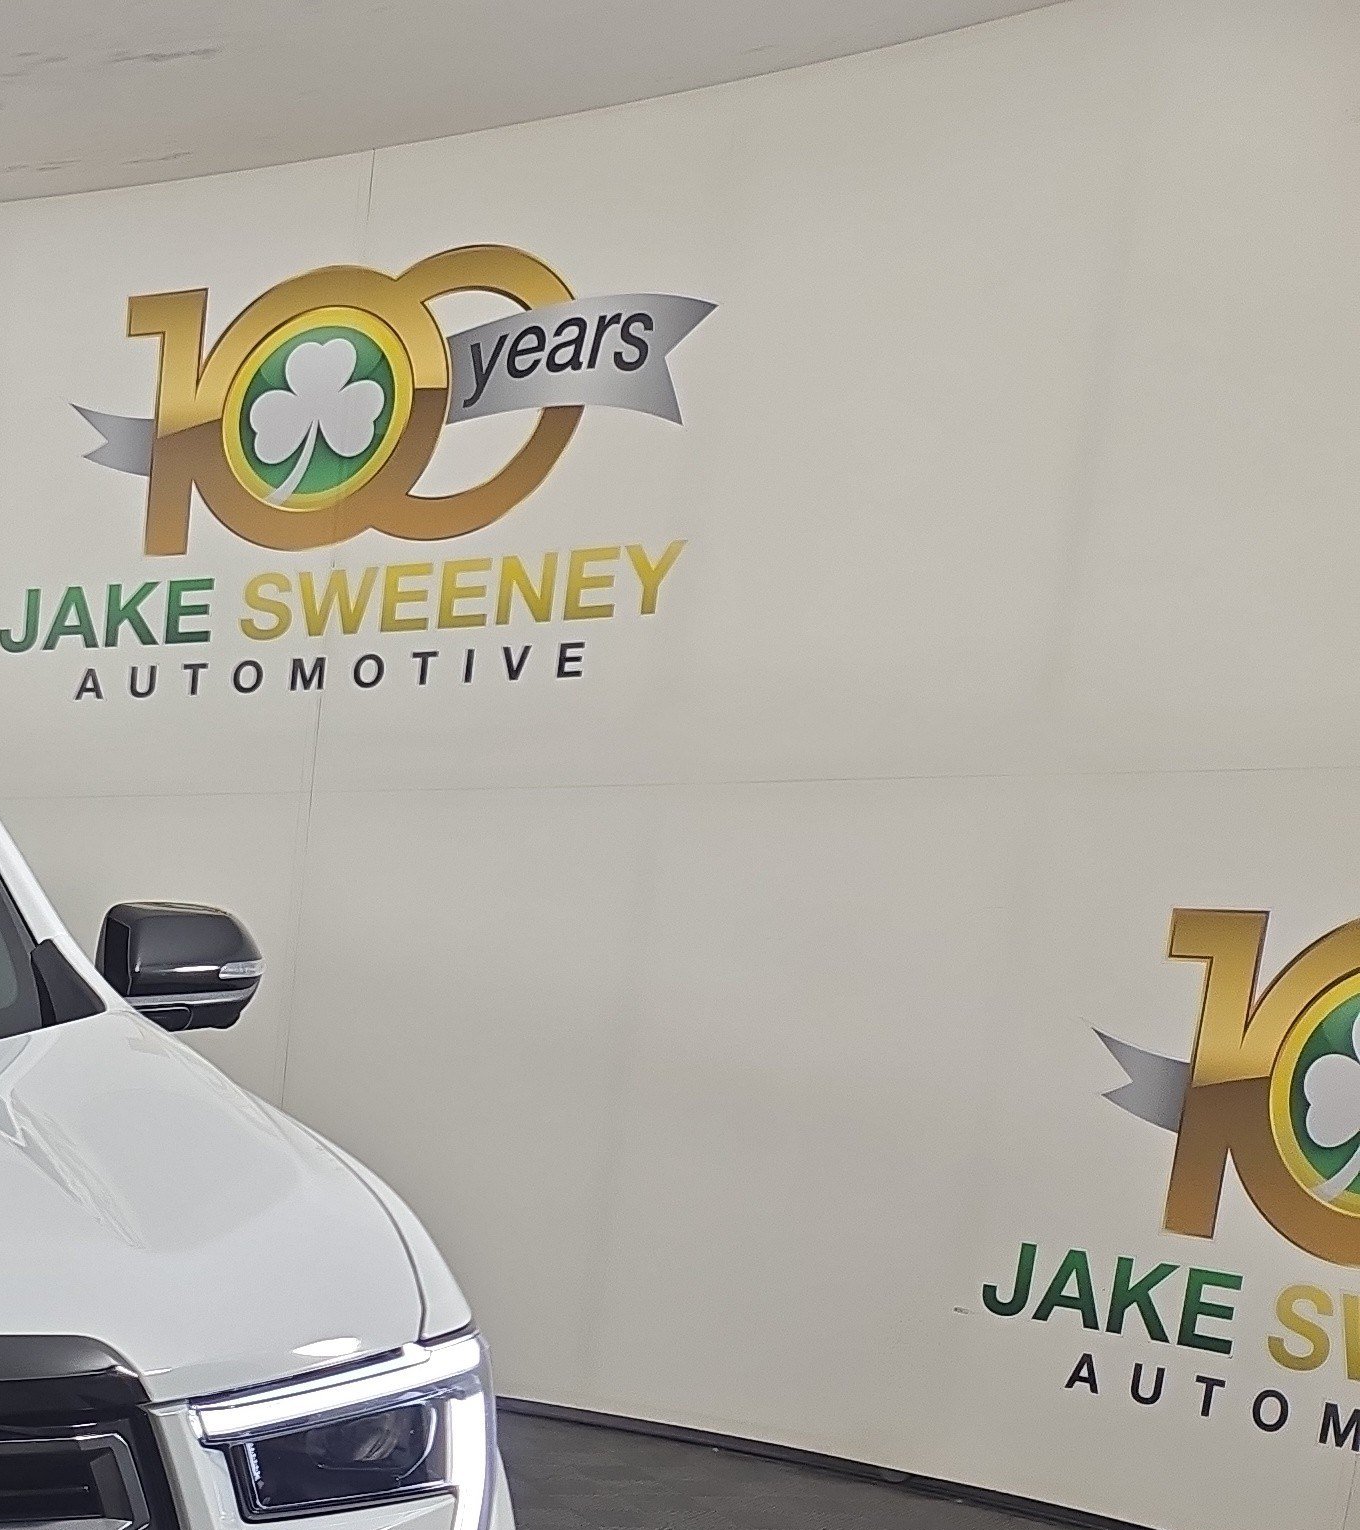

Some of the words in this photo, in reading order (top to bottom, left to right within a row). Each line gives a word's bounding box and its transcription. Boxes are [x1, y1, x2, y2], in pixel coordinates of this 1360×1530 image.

[127, 244, 584, 556] 100
[462, 310, 654, 408] years
[0, 577, 215, 654] JAKE
[239, 539, 687, 640] SWEENEY
[75, 641, 585, 700] AUTOMOTIVE
[982, 1243, 1243, 1355] JAKE
[1064, 1353, 1360, 1453] AUTOM
